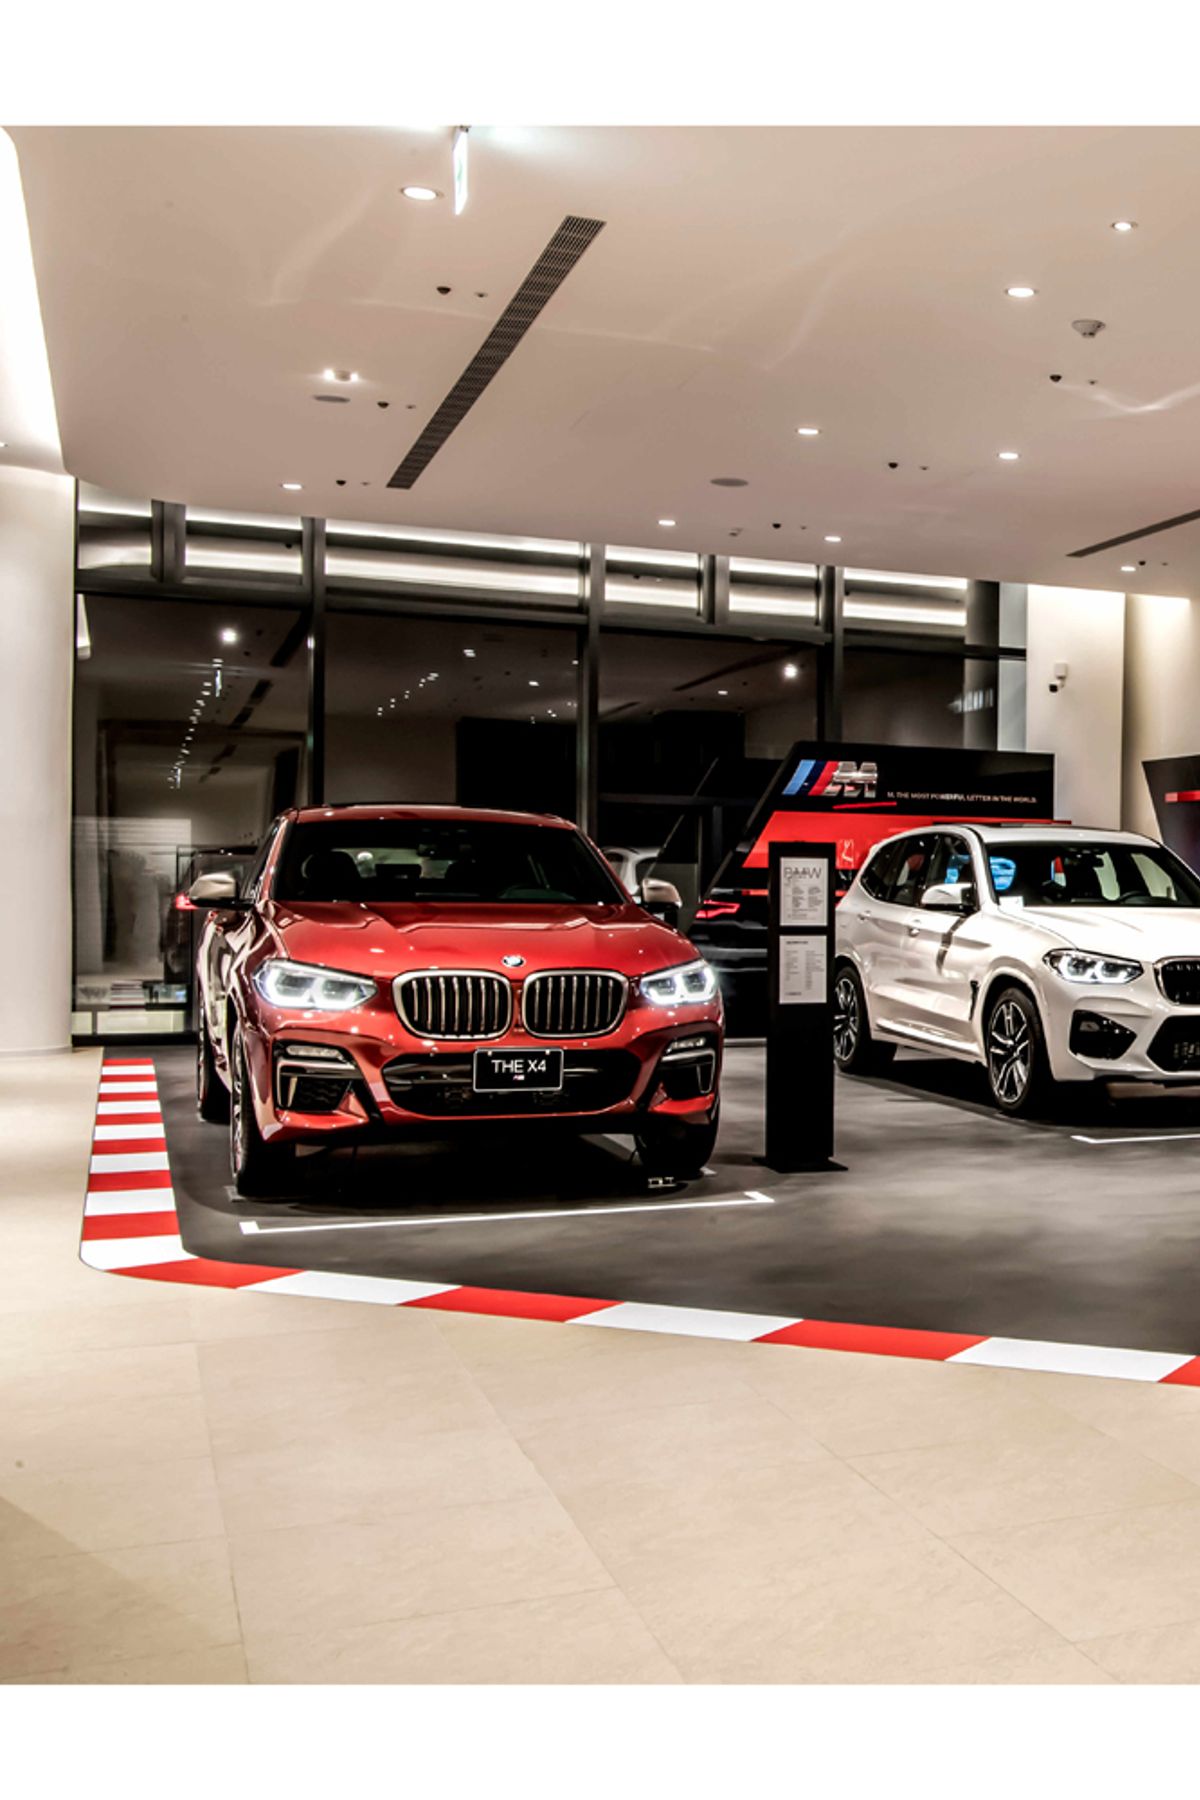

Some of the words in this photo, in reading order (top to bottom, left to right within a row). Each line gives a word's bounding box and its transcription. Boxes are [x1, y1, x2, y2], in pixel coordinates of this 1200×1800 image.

[896, 791, 910, 799] THE
[911, 792, 930, 800] MOST
[491, 1059, 525, 1074] THE
[527, 1059, 547, 1073] X4
